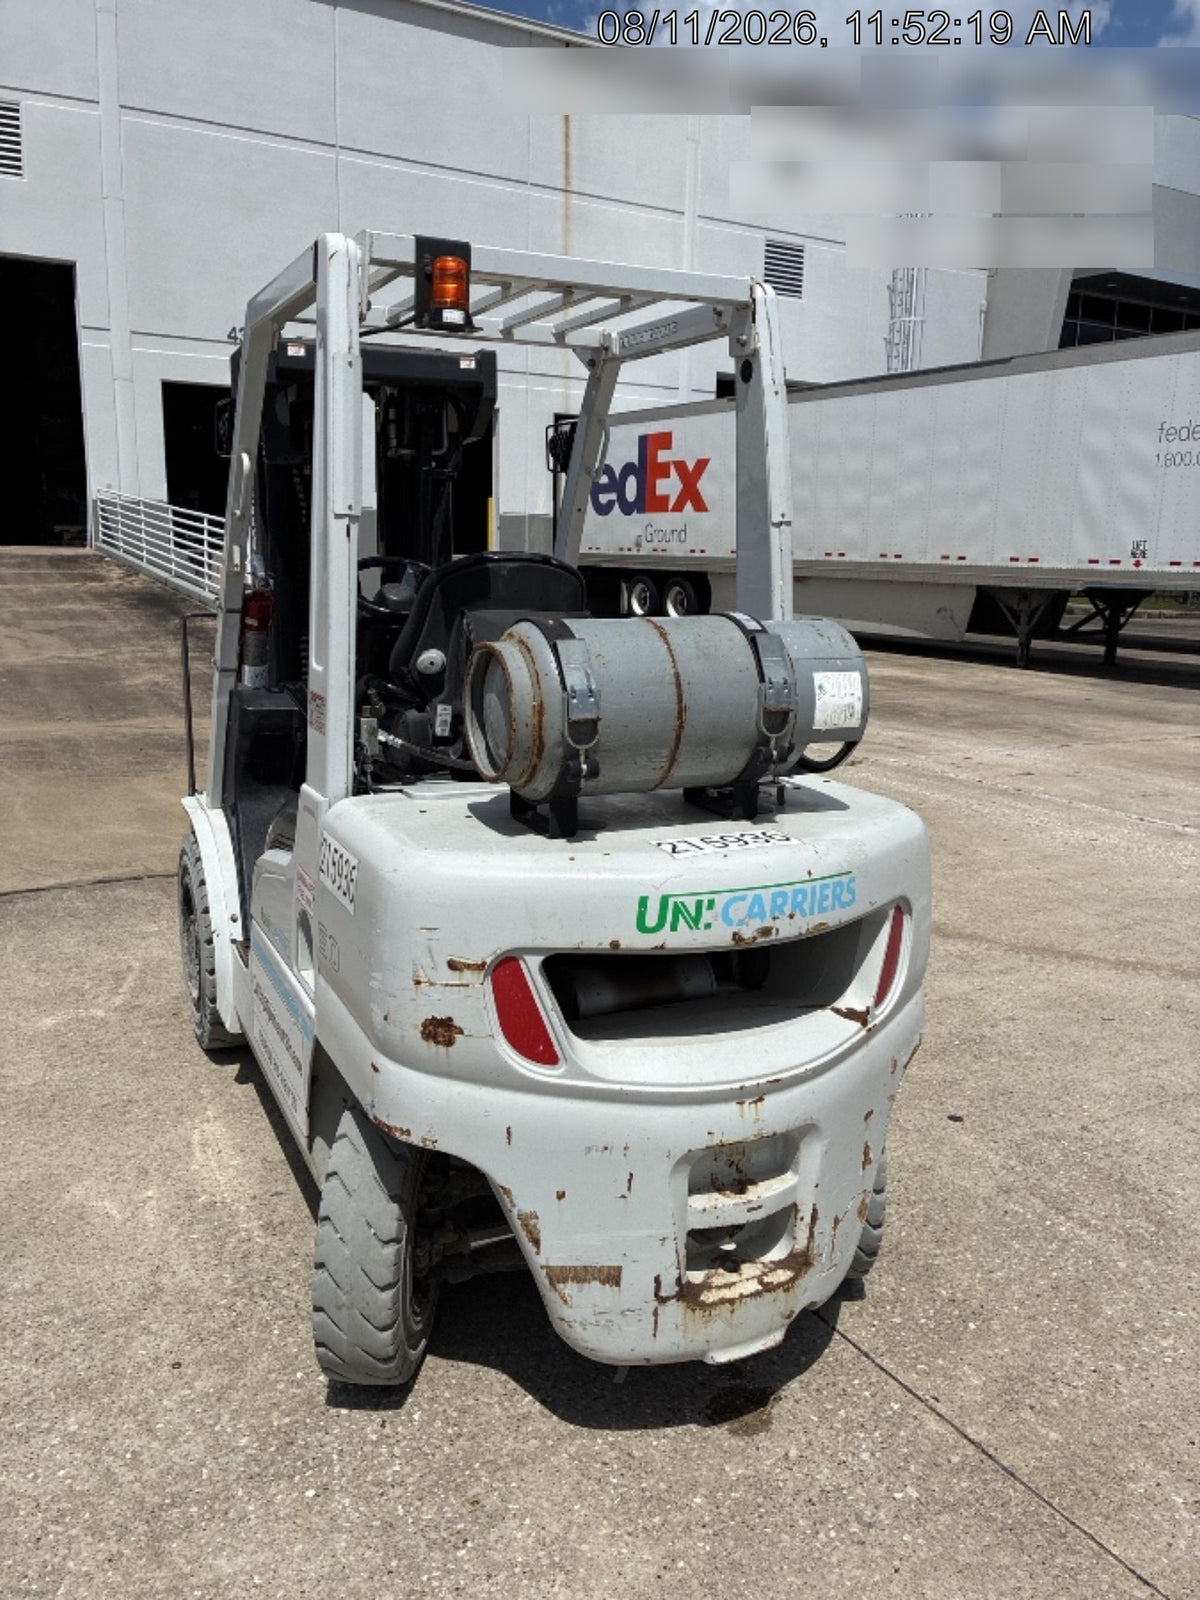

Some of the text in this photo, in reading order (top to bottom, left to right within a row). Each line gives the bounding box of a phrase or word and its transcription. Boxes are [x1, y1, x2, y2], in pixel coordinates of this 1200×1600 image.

[1154, 451, 1200, 469] 1.800.
[589, 431, 712, 517] edEx
[644, 522, 688, 544] Ground
